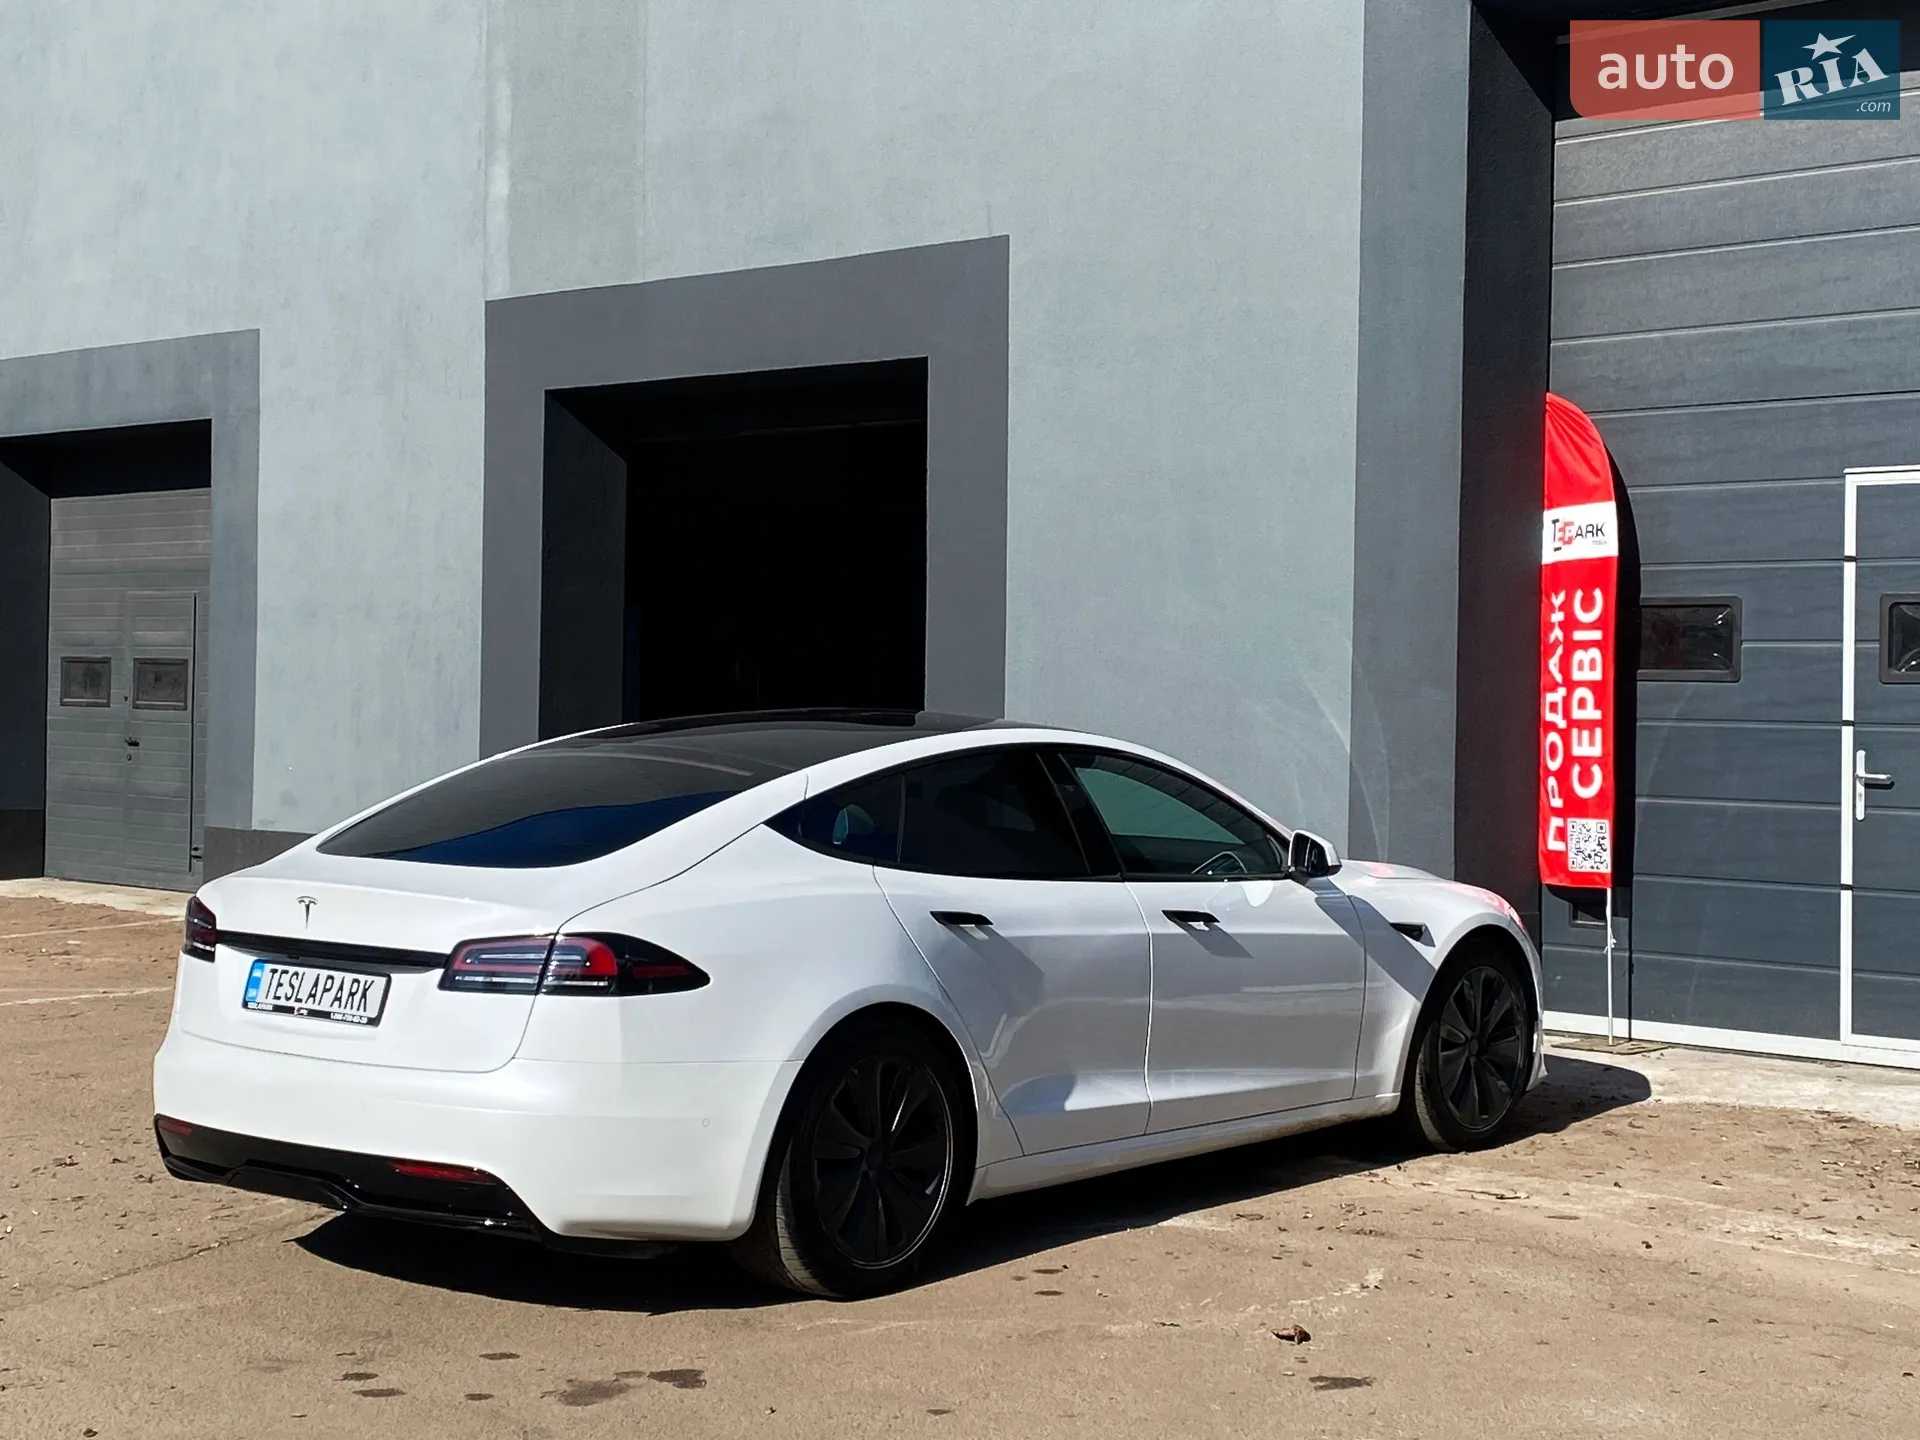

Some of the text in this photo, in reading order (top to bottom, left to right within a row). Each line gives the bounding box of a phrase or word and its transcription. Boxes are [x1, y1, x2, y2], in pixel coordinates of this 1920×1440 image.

[1546, 589, 1566, 851] ПРОДАЖ
[1572, 588, 1603, 799] СЕРВІС
[265, 968, 375, 1013] TESLAPARK
